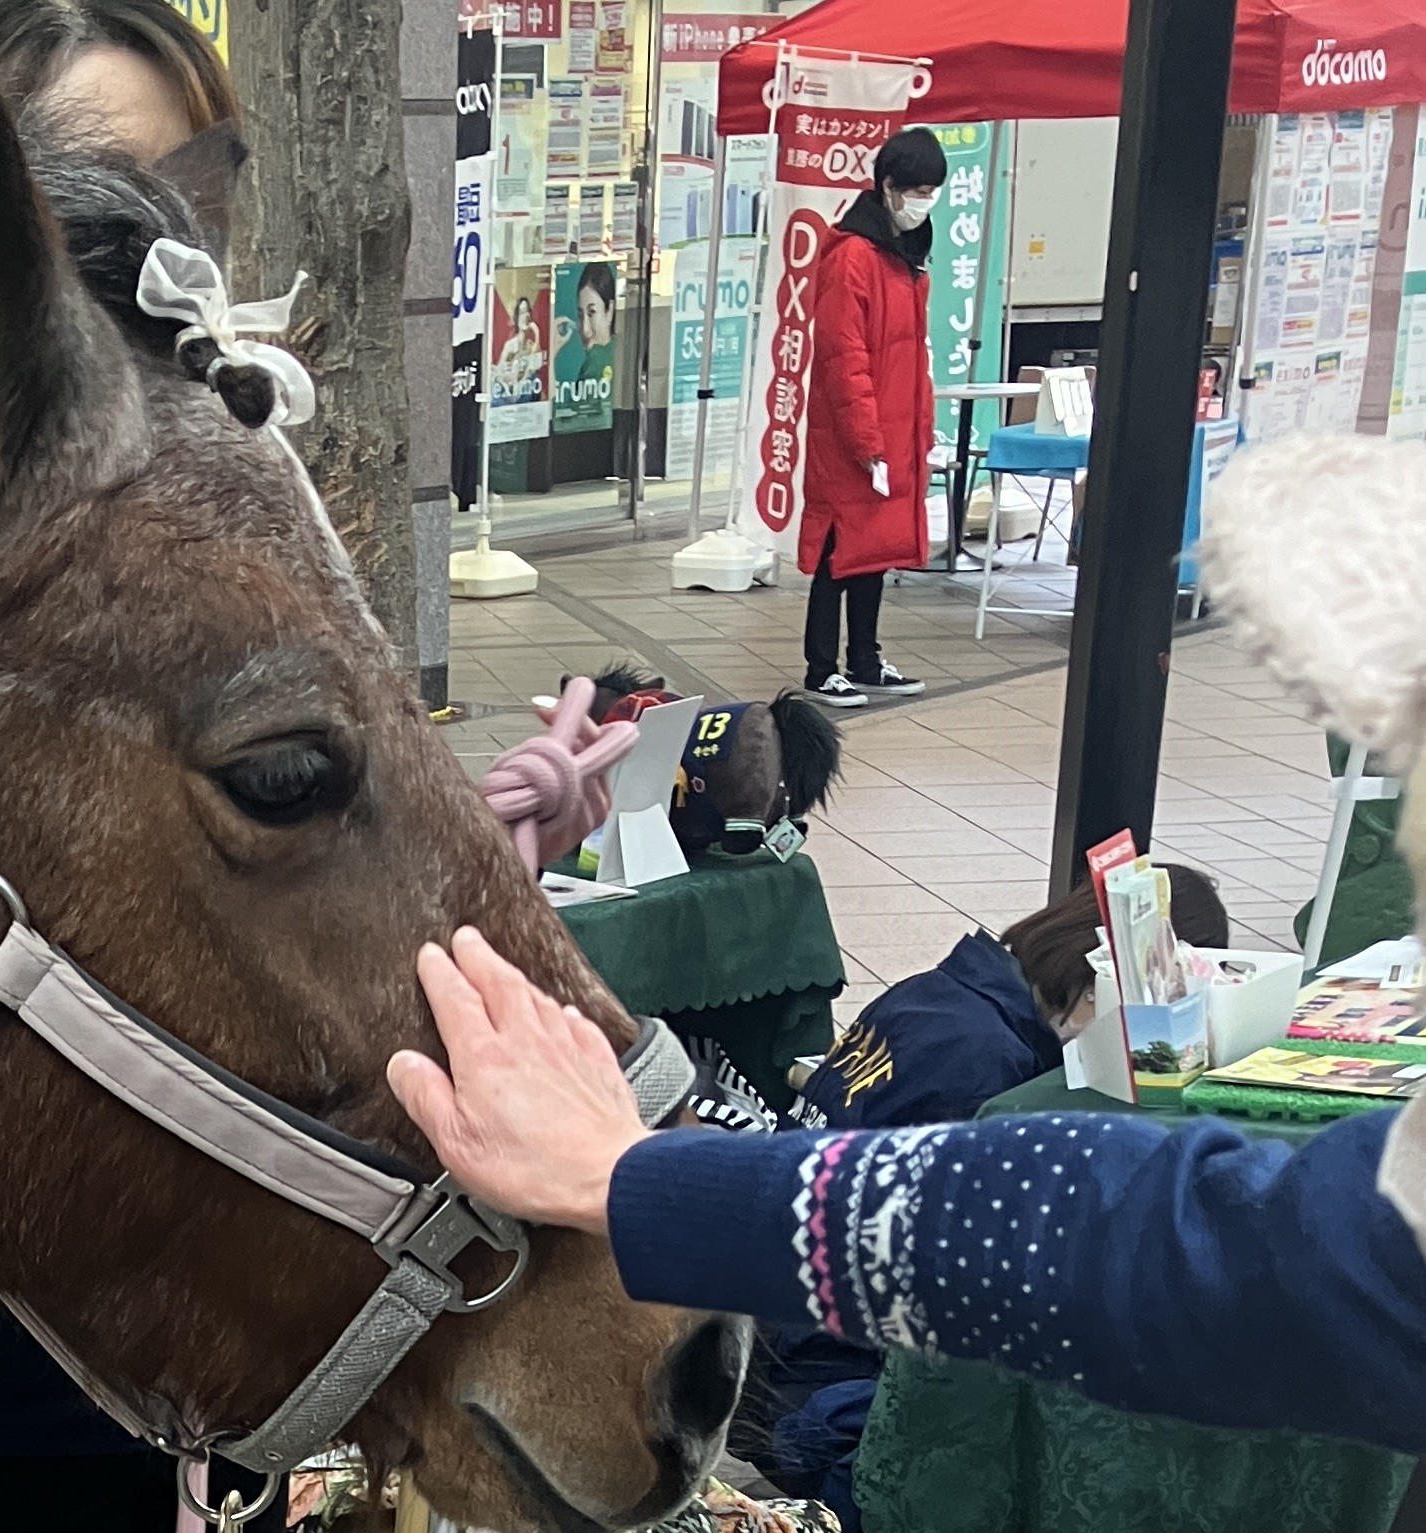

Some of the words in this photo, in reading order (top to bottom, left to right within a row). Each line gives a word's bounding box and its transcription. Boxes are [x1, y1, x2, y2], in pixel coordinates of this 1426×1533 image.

[1302, 38, 1386, 86] docomo
[554, 376, 611, 404] irumo
[697, 712, 732, 741] 13
